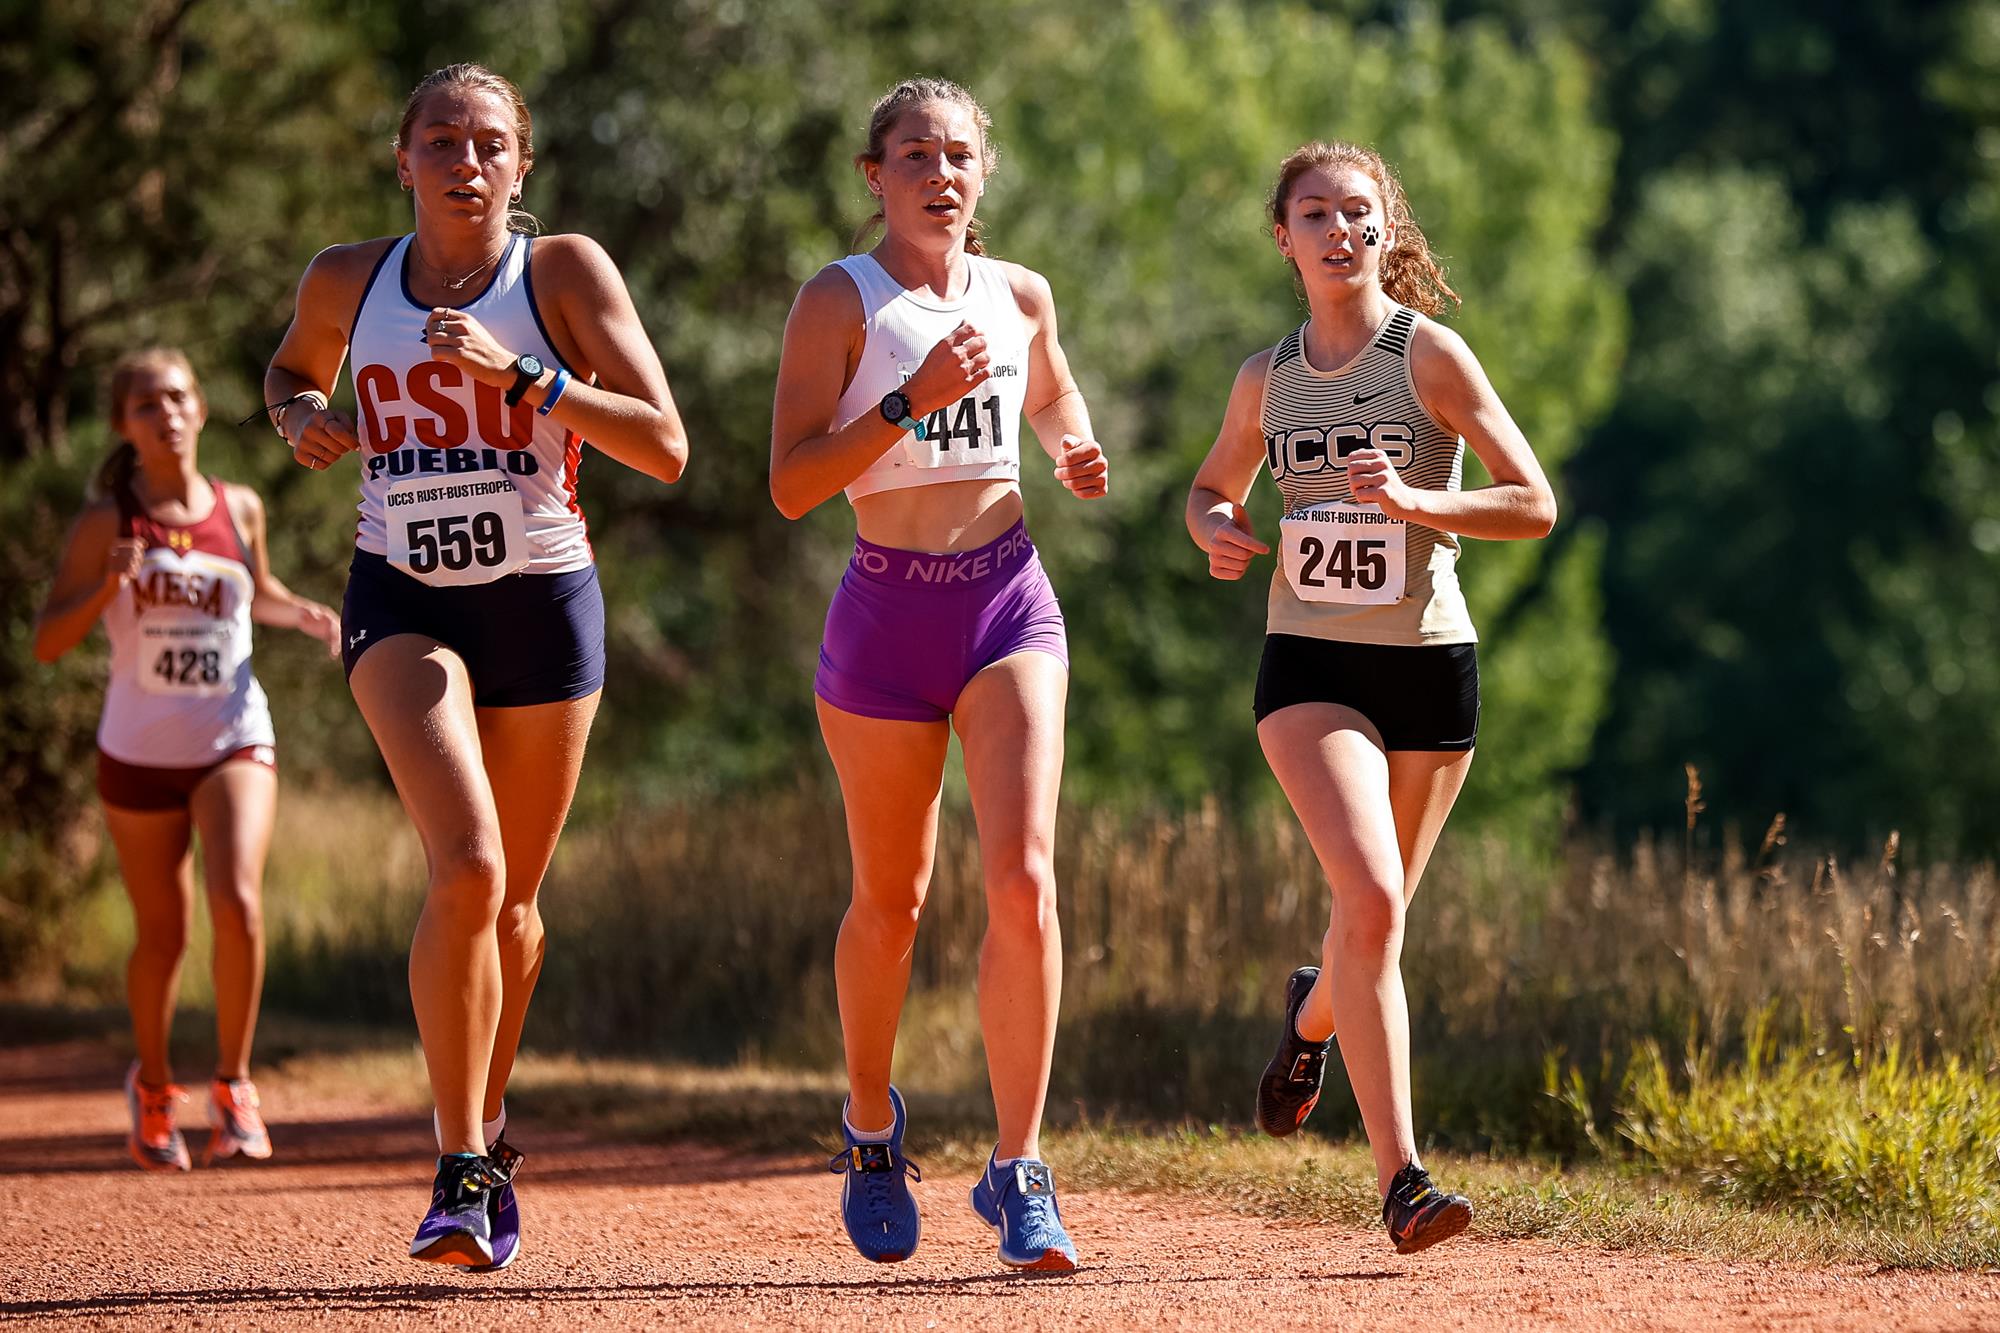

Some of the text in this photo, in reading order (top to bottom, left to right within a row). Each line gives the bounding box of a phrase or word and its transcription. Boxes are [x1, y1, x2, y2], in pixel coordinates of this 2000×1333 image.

[356, 361, 534, 454] CSU
[924, 395, 1003, 452] 441
[1265, 420, 1416, 483] UCCS
[387, 491, 415, 507] UCCS
[406, 511, 507, 575] 559
[854, 544, 888, 574] RO
[905, 552, 992, 583] NIKE
[1299, 535, 1387, 590] 245
[131, 571, 223, 617] MESA
[154, 647, 221, 685] 428
